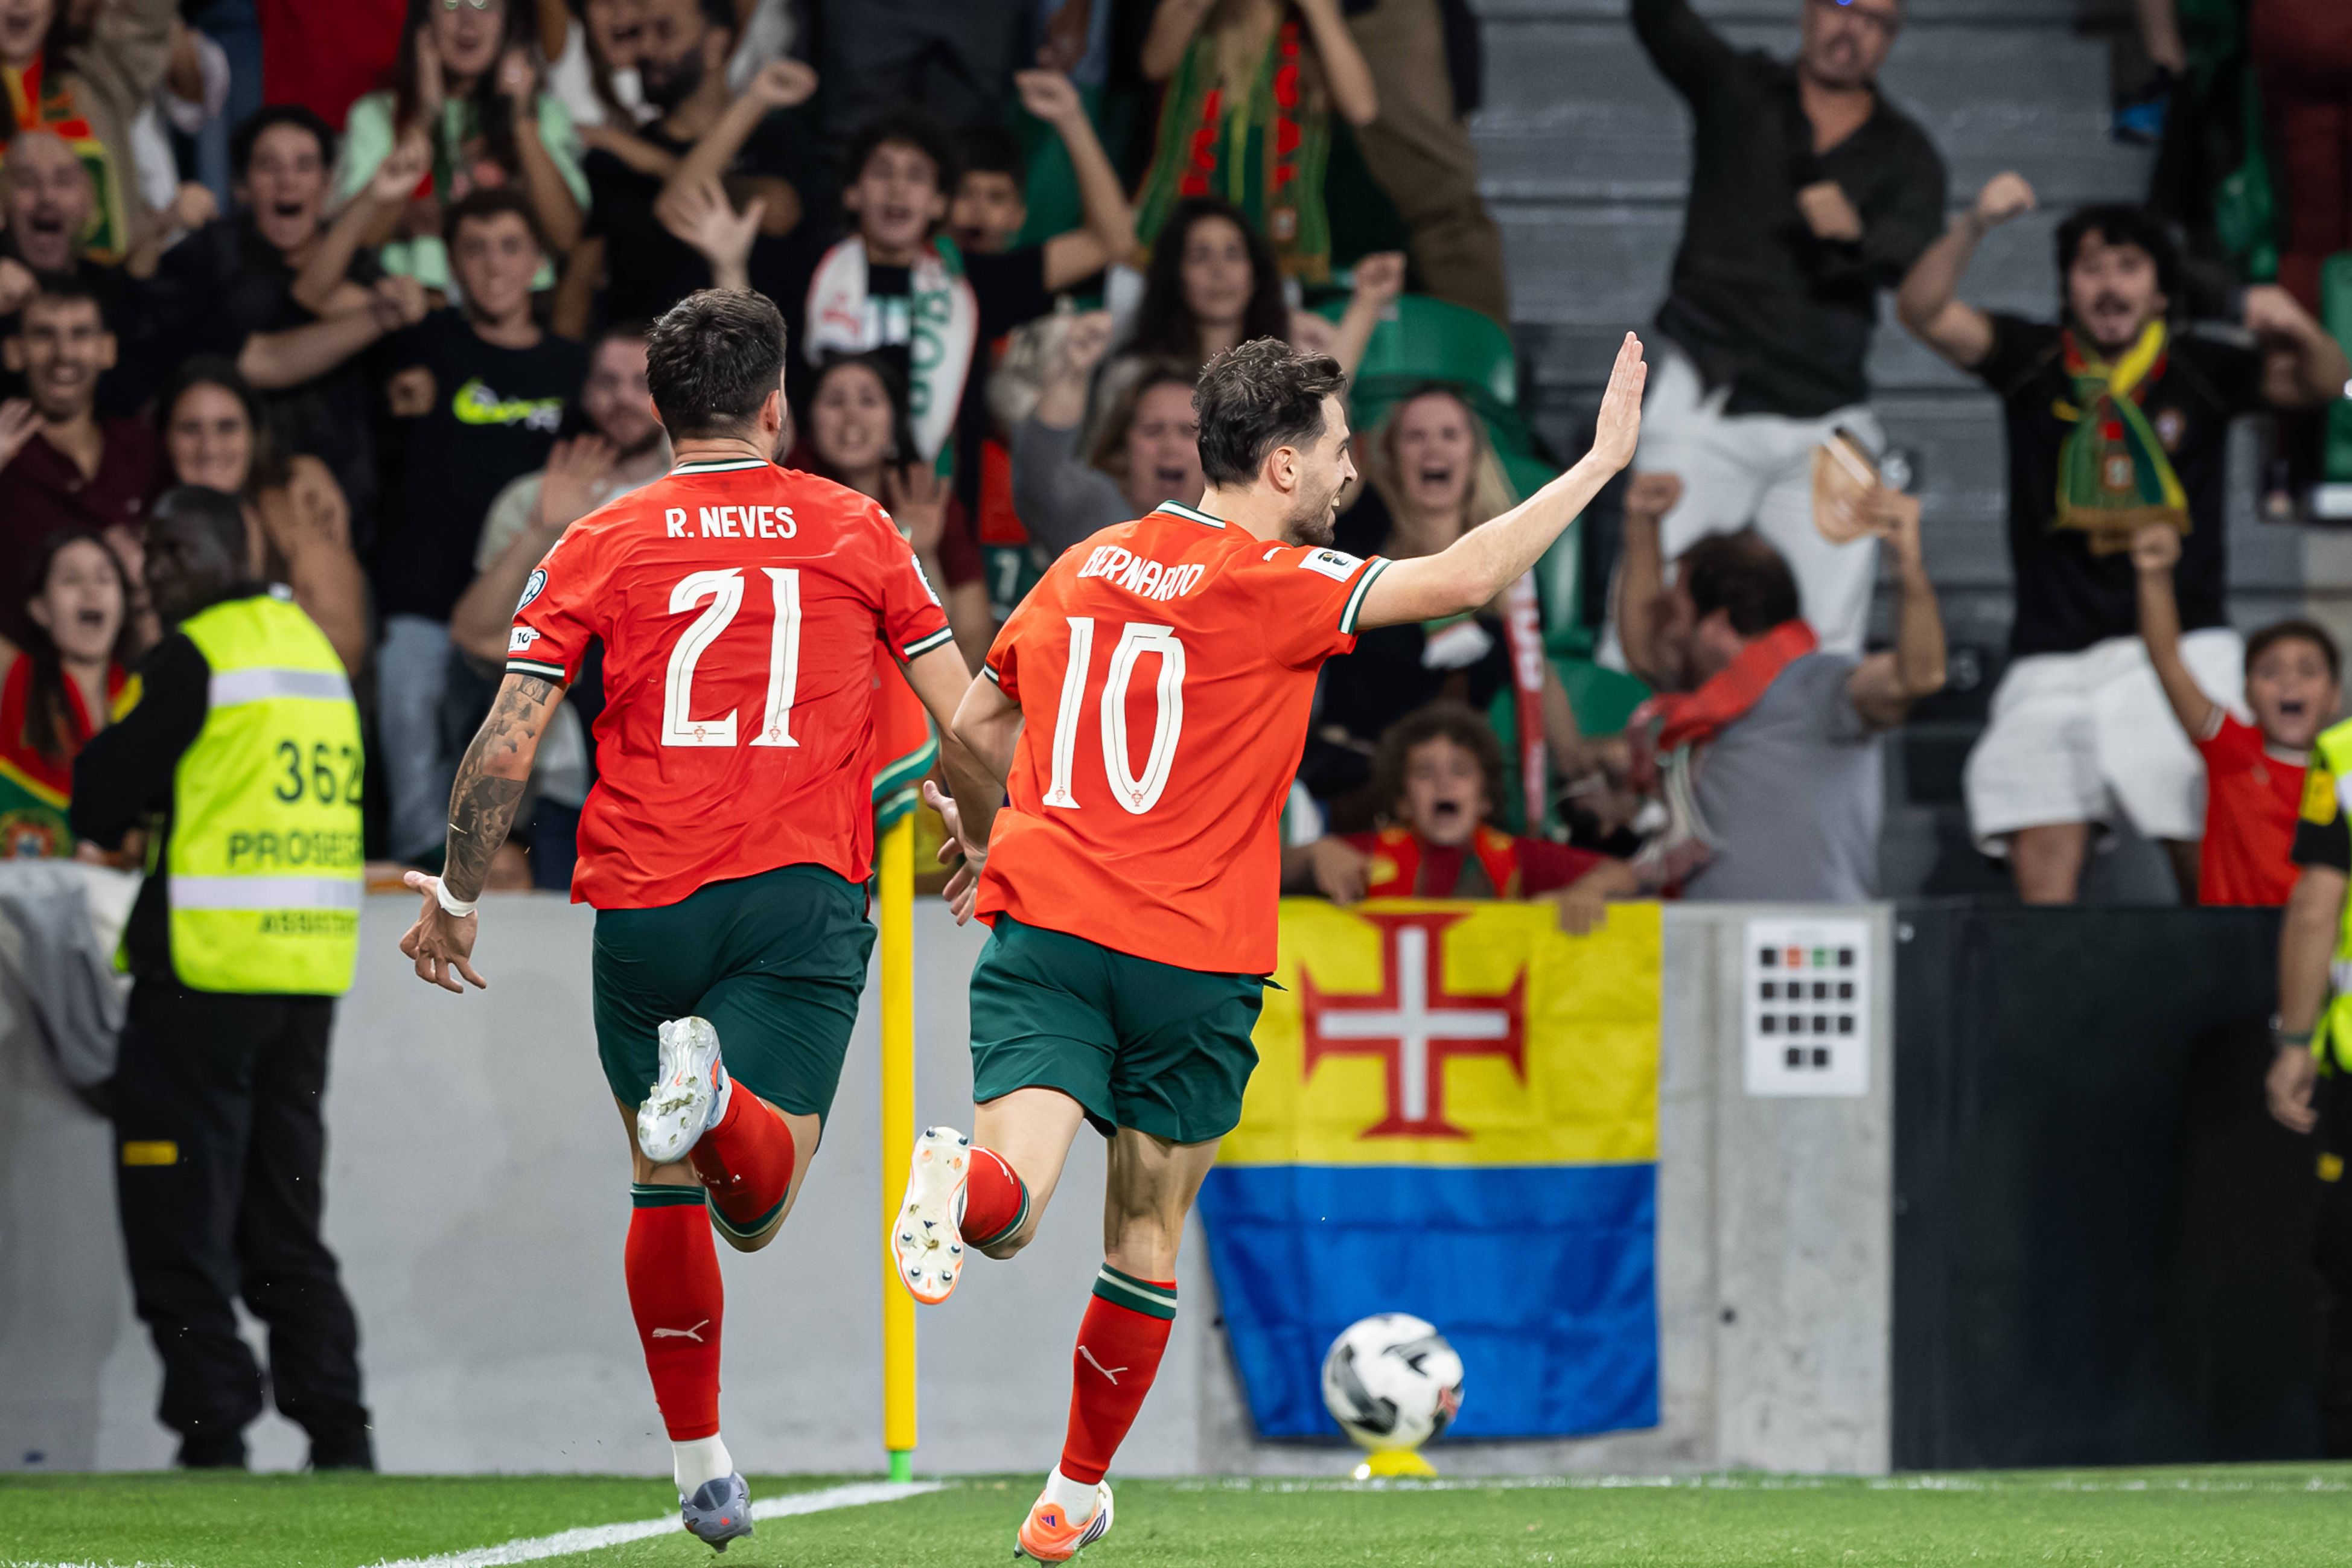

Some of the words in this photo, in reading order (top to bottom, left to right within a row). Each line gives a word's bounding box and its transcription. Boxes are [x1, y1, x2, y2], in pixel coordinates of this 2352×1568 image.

[665, 507, 695, 538] R.
[699, 506, 797, 539] NEVES
[1077, 546, 1205, 602] BERNARDO
[661, 567, 802, 747] 21
[1042, 617, 1187, 815] 10
